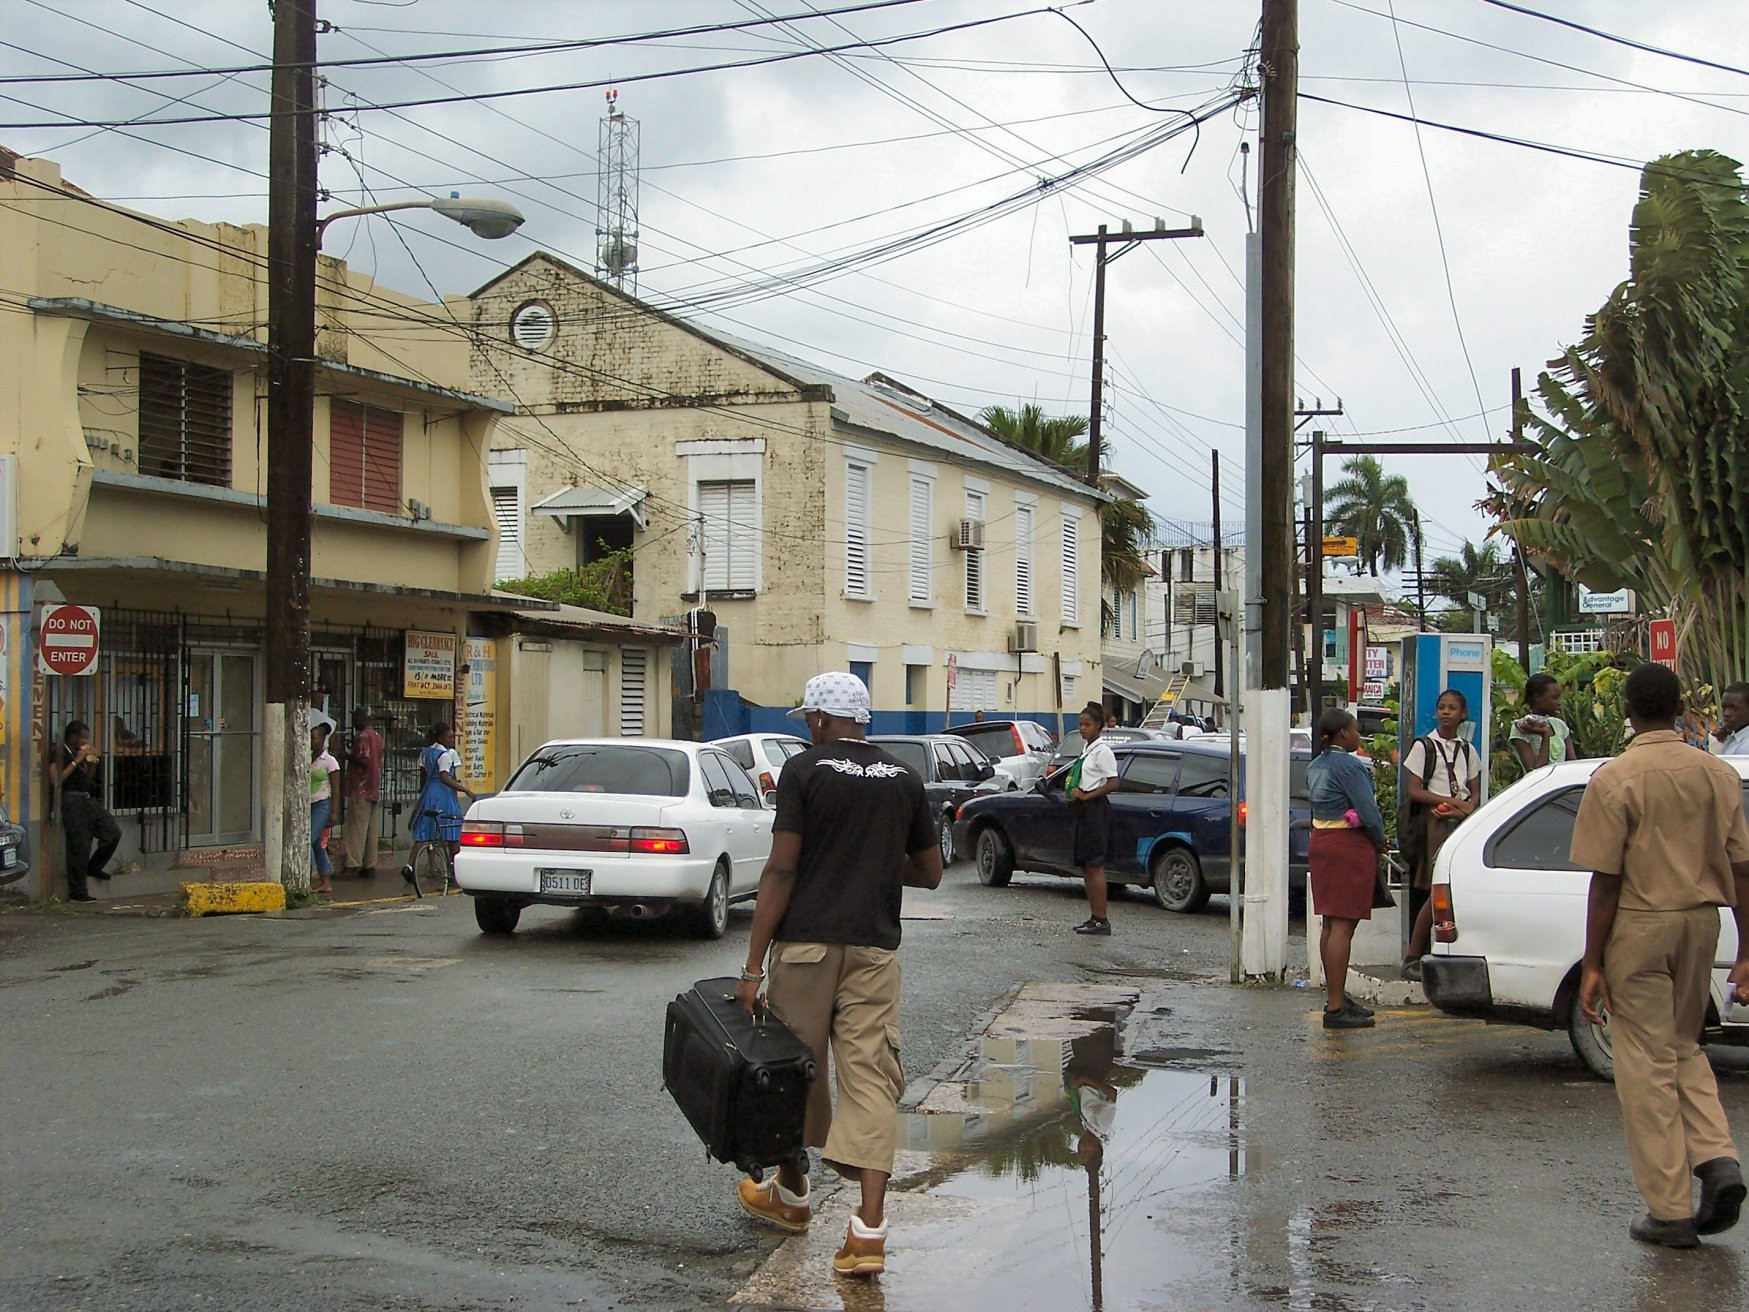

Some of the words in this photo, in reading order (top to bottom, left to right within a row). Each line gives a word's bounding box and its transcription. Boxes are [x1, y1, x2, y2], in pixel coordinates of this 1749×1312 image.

[1583, 595, 1625, 605] Advantage
[48, 618, 66, 629] DO
[69, 619, 92, 631] NOT
[407, 634, 420, 649] BIG
[420, 635, 454, 651] CLEARANCE
[1656, 631, 1669, 650] NO
[50, 651, 86, 663] ENTER
[465, 644, 472, 658] R
[474, 645, 481, 658] &
[483, 645, 491, 658] H
[1449, 647, 1480, 657] Phone
[471, 673, 485, 686] LTD.
